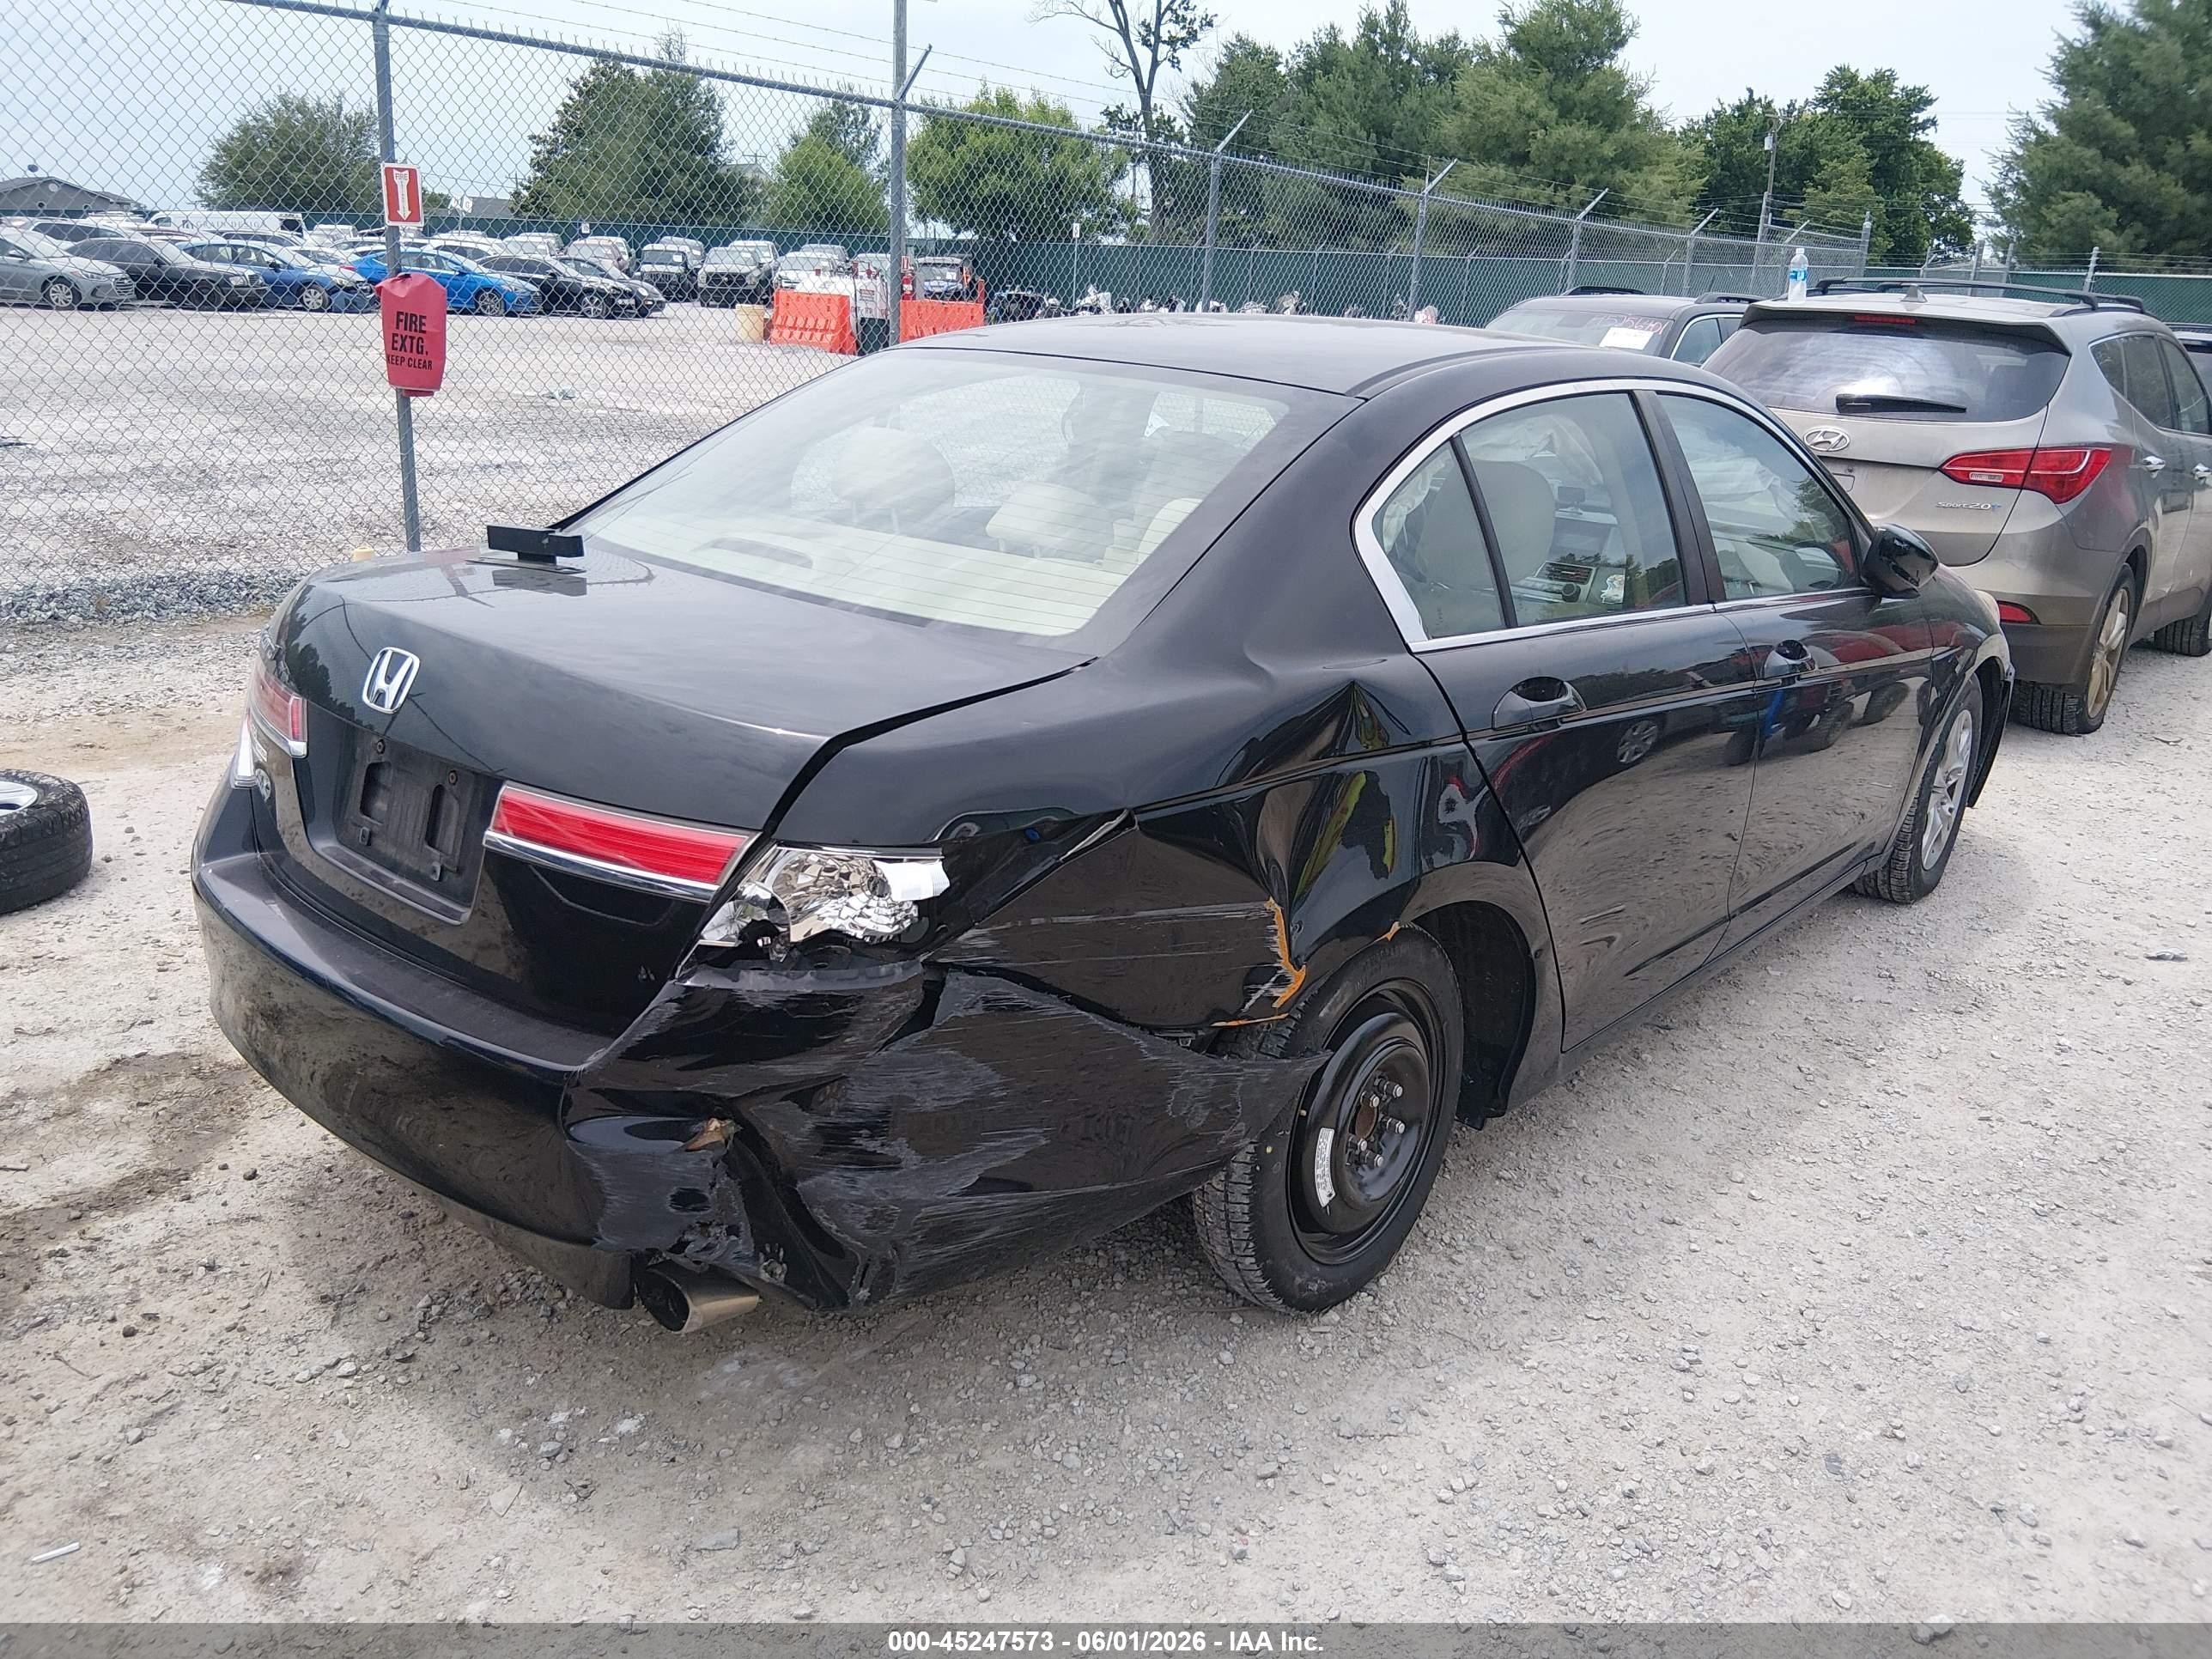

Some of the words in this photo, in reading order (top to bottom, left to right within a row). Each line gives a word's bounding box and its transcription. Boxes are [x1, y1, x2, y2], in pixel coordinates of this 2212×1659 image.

[396, 311, 427, 334] FIRE
[392, 332, 428, 356] EXTG.
[386, 354, 405, 366] KEEP
[407, 356, 433, 371] CLEAR
